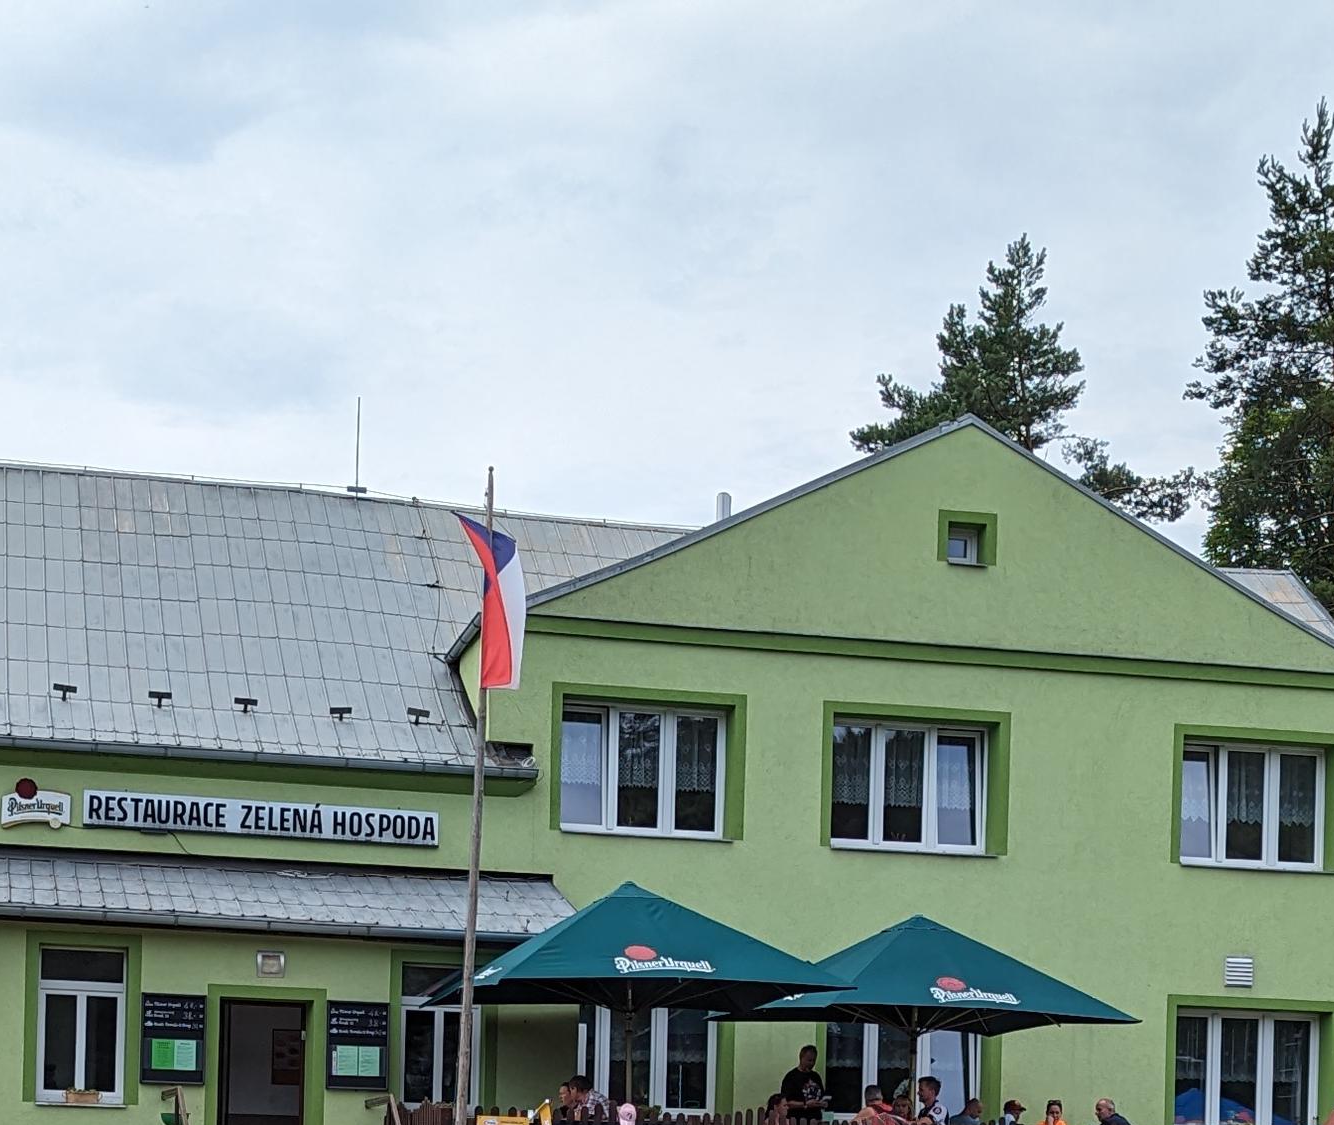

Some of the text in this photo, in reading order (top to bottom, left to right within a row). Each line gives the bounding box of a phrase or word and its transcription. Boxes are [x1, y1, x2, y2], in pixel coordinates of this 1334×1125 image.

[88, 794, 436, 841] RESTAURACE ZELENÁ HOSPODA
